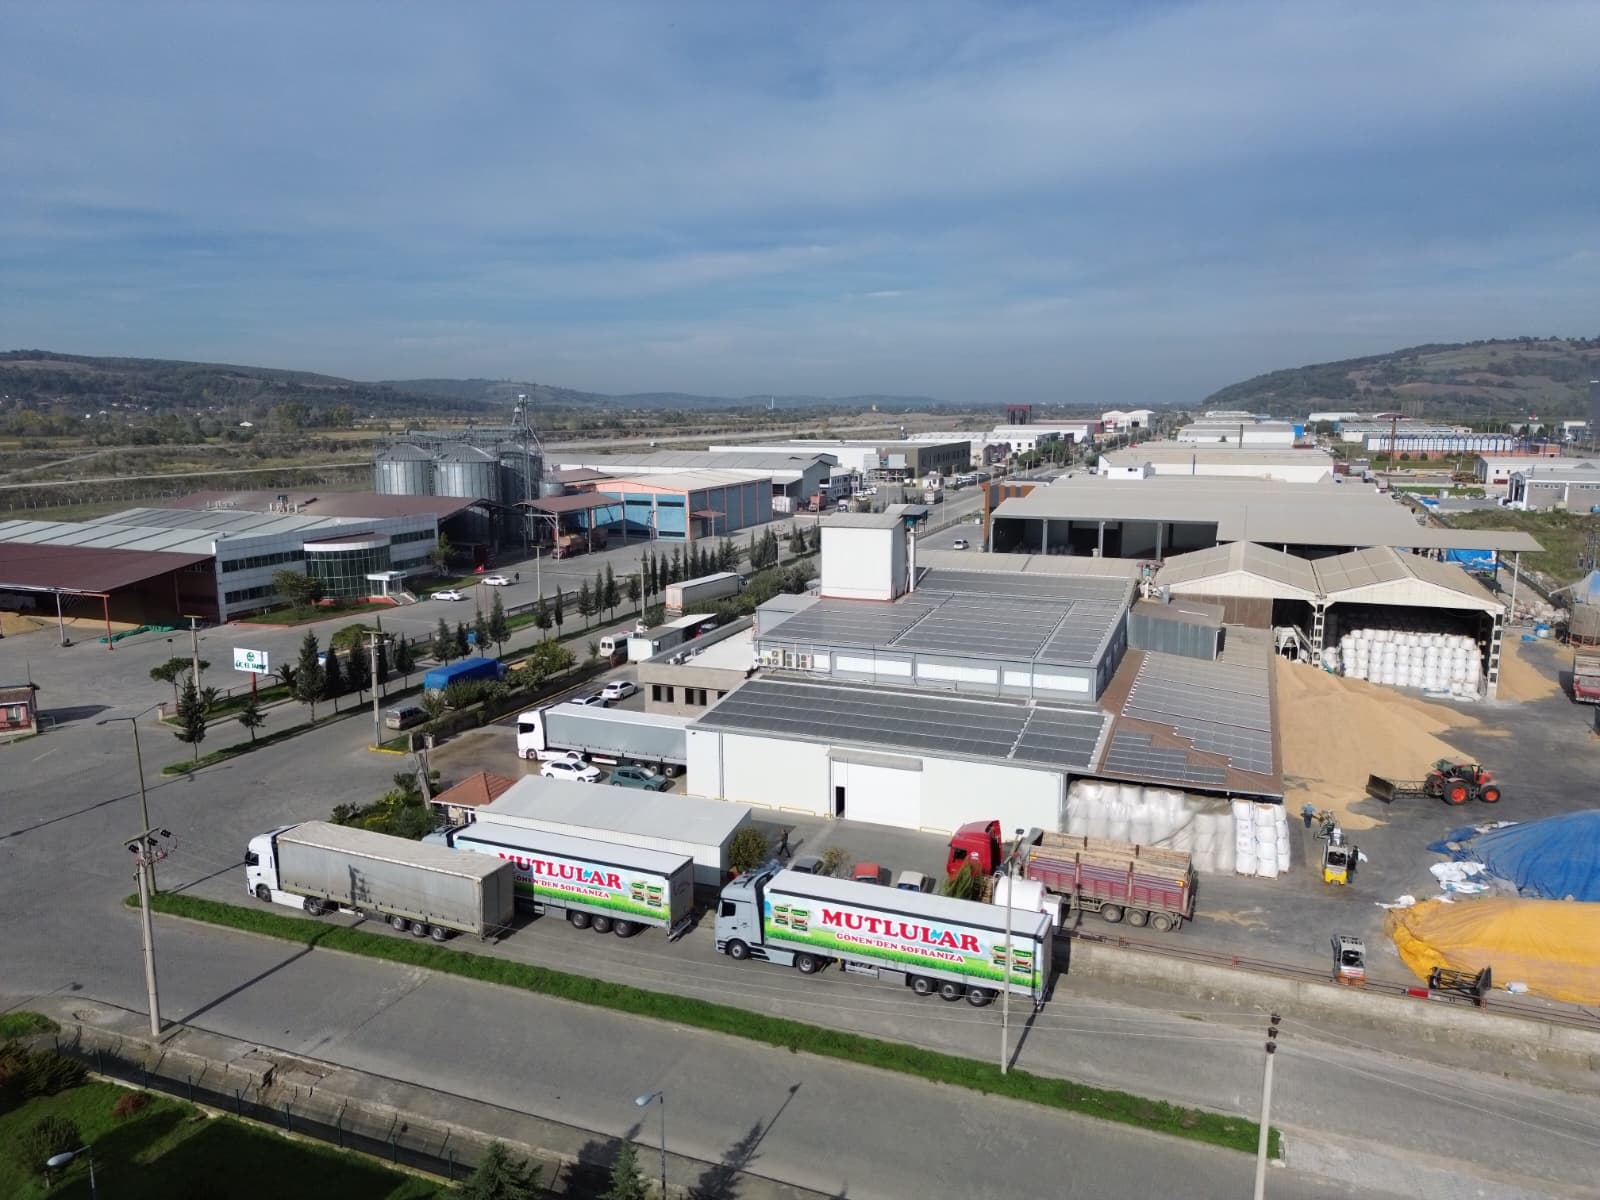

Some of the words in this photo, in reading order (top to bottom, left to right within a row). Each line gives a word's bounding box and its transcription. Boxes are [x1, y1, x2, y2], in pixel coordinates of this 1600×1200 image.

[821, 908, 981, 953] MUTLULAR
[836, 932, 898, 950] GÖNEN'DEN
[901, 944, 964, 964] SOFRANIZA
